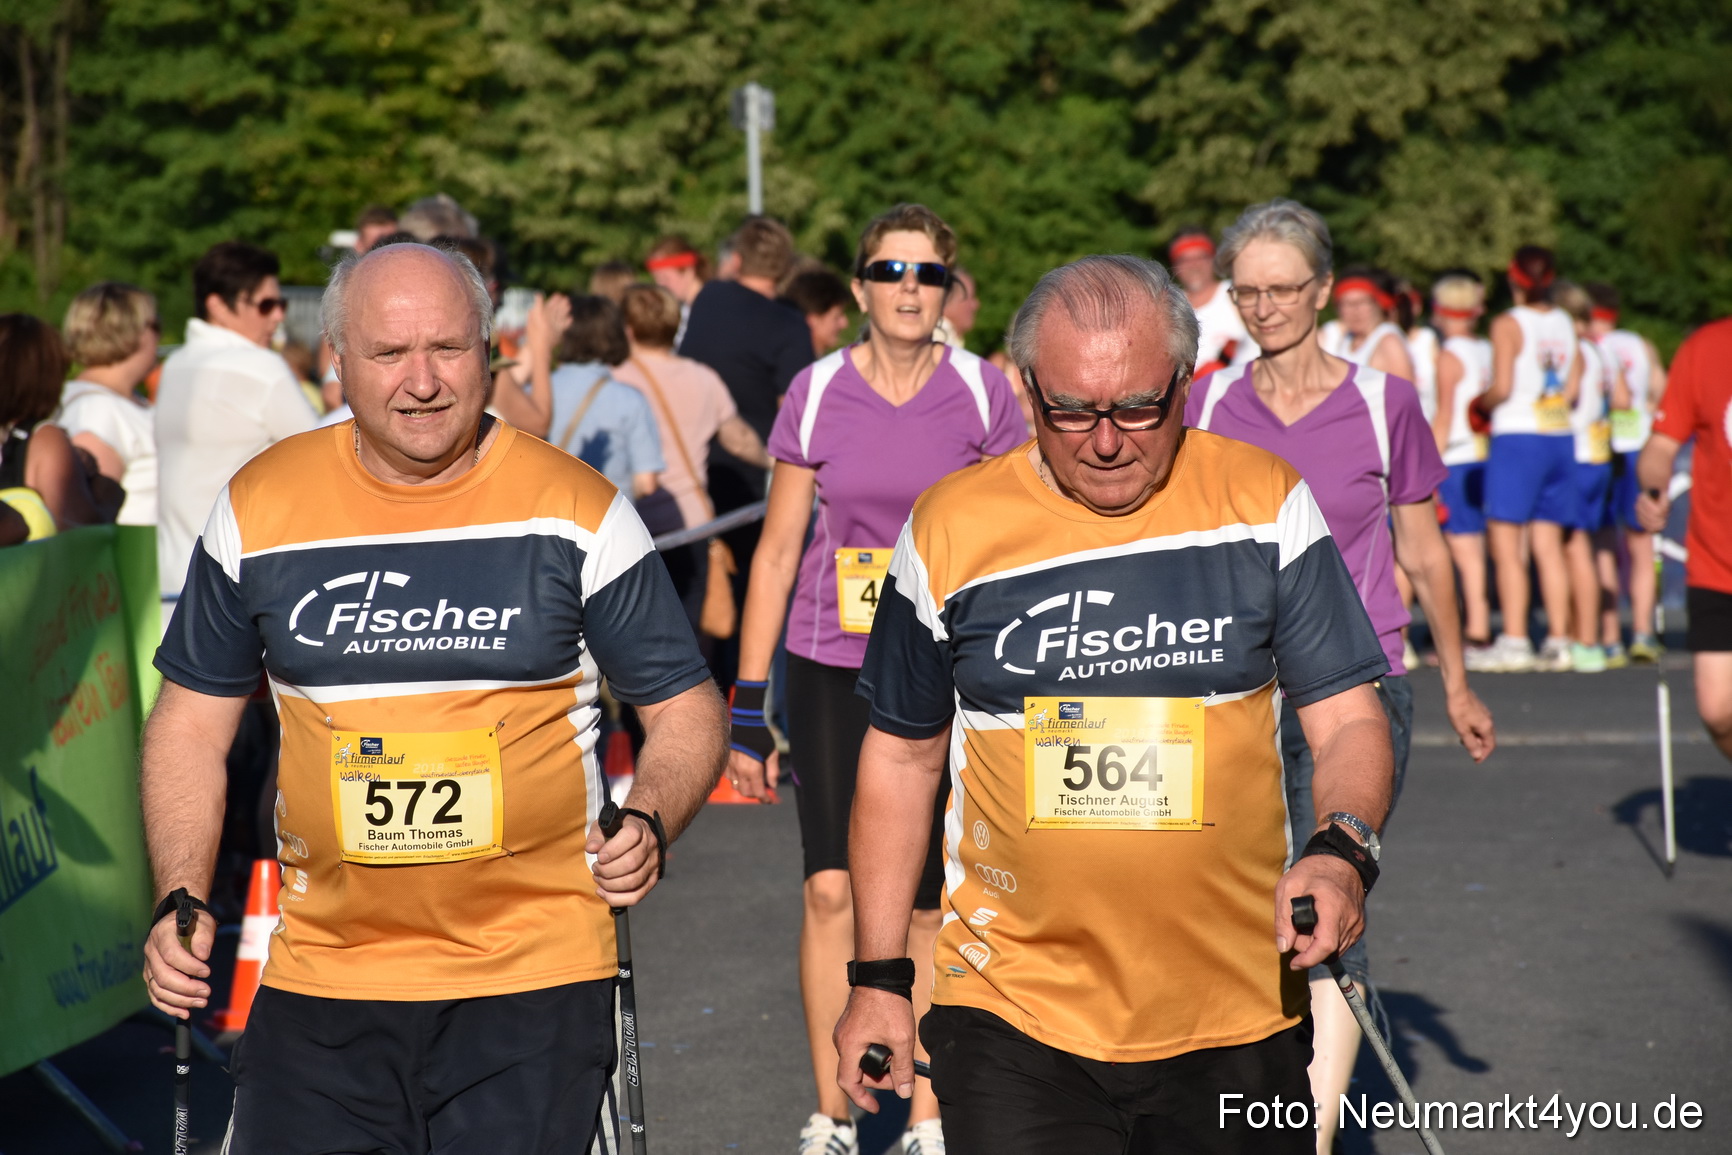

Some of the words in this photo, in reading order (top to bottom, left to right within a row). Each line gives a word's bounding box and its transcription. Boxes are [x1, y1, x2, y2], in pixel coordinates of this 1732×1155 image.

[326, 598, 522, 636] Fischer
[1036, 613, 1233, 663] Fischer
[343, 635, 507, 655] AUTOMOBILE
[1058, 648, 1225, 682] AUTOMOBILE
[1047, 717, 1106, 729] firmenlauf
[1035, 735, 1081, 748] walken
[351, 753, 405, 765] firmenlauf
[412, 763, 445, 774] 2018
[1062, 744, 1164, 792] 564
[340, 770, 381, 783] walken
[365, 779, 463, 826] 572
[1058, 794, 1116, 806] Tischner
[1119, 794, 1169, 808] August
[1054, 808, 1087, 817] Fischer
[1089, 808, 1141, 817] Automobile
[1143, 808, 1172, 817] GmbH
[368, 829, 405, 841] Baum
[409, 828, 463, 840] Thomas
[358, 842, 389, 851] Fischer
[391, 842, 443, 851] Automobile
[445, 838, 473, 849] GmbH
[983, 887, 1000, 900] Audi
[964, 947, 985, 966] FIAT
[621, 1010, 640, 1088] WALKER
